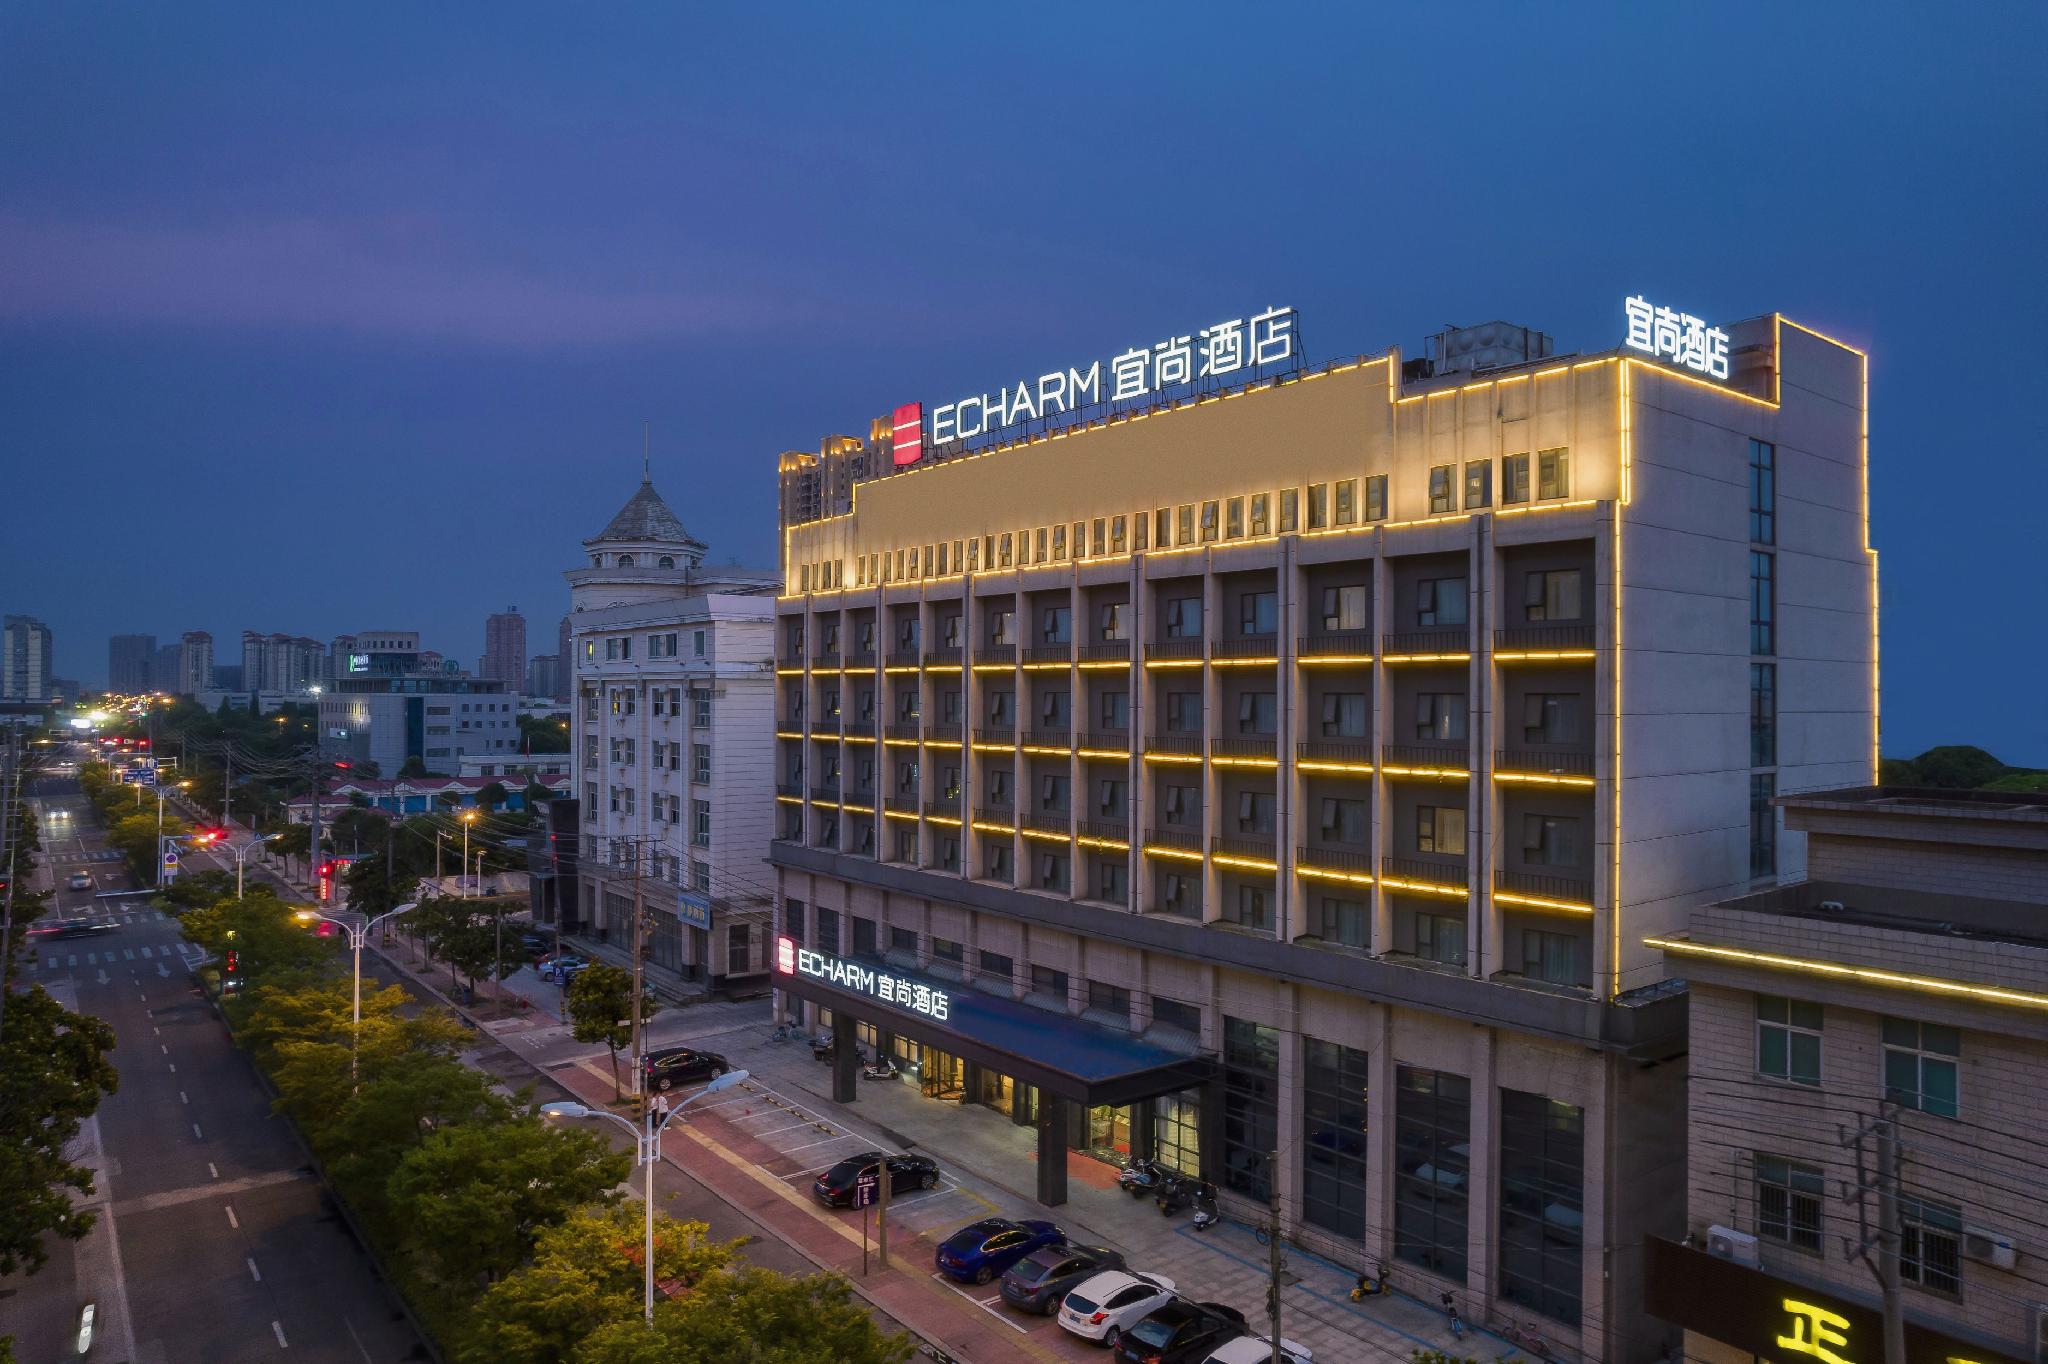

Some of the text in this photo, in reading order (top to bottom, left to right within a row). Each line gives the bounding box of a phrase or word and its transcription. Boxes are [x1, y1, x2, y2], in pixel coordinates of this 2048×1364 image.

[932, 305, 1292, 446] ECHARM 宜尚酒店
[1625, 294, 1729, 380] 宜尚酒店
[798, 948, 949, 1021] ECHARM 宜尚酒店
